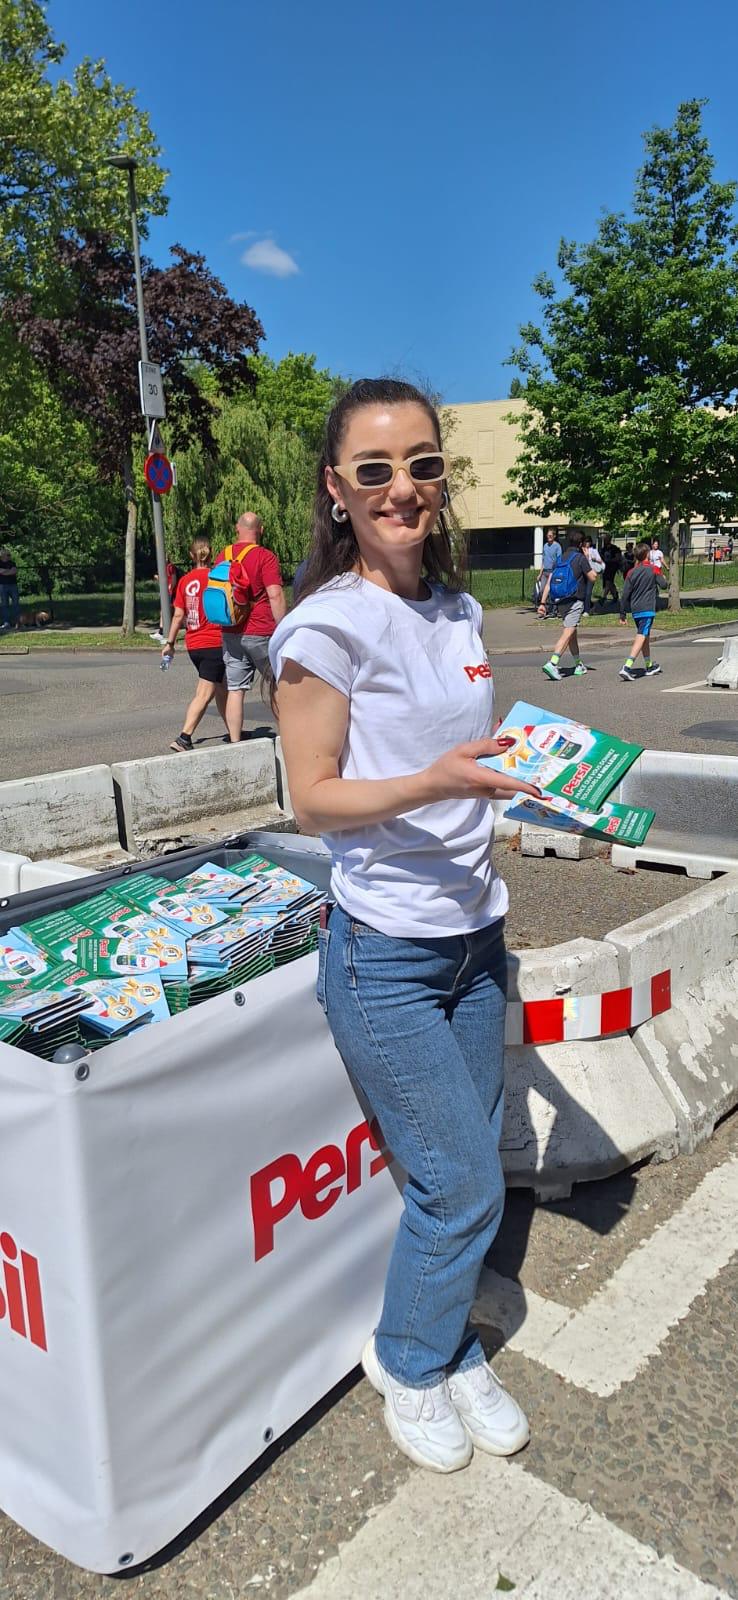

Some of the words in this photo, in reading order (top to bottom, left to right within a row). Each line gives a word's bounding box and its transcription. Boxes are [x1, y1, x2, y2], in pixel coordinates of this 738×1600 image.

[148, 383, 158, 396] 30
[590, 763, 603, 776] VOUS
[562, 762, 591, 794] Persil
